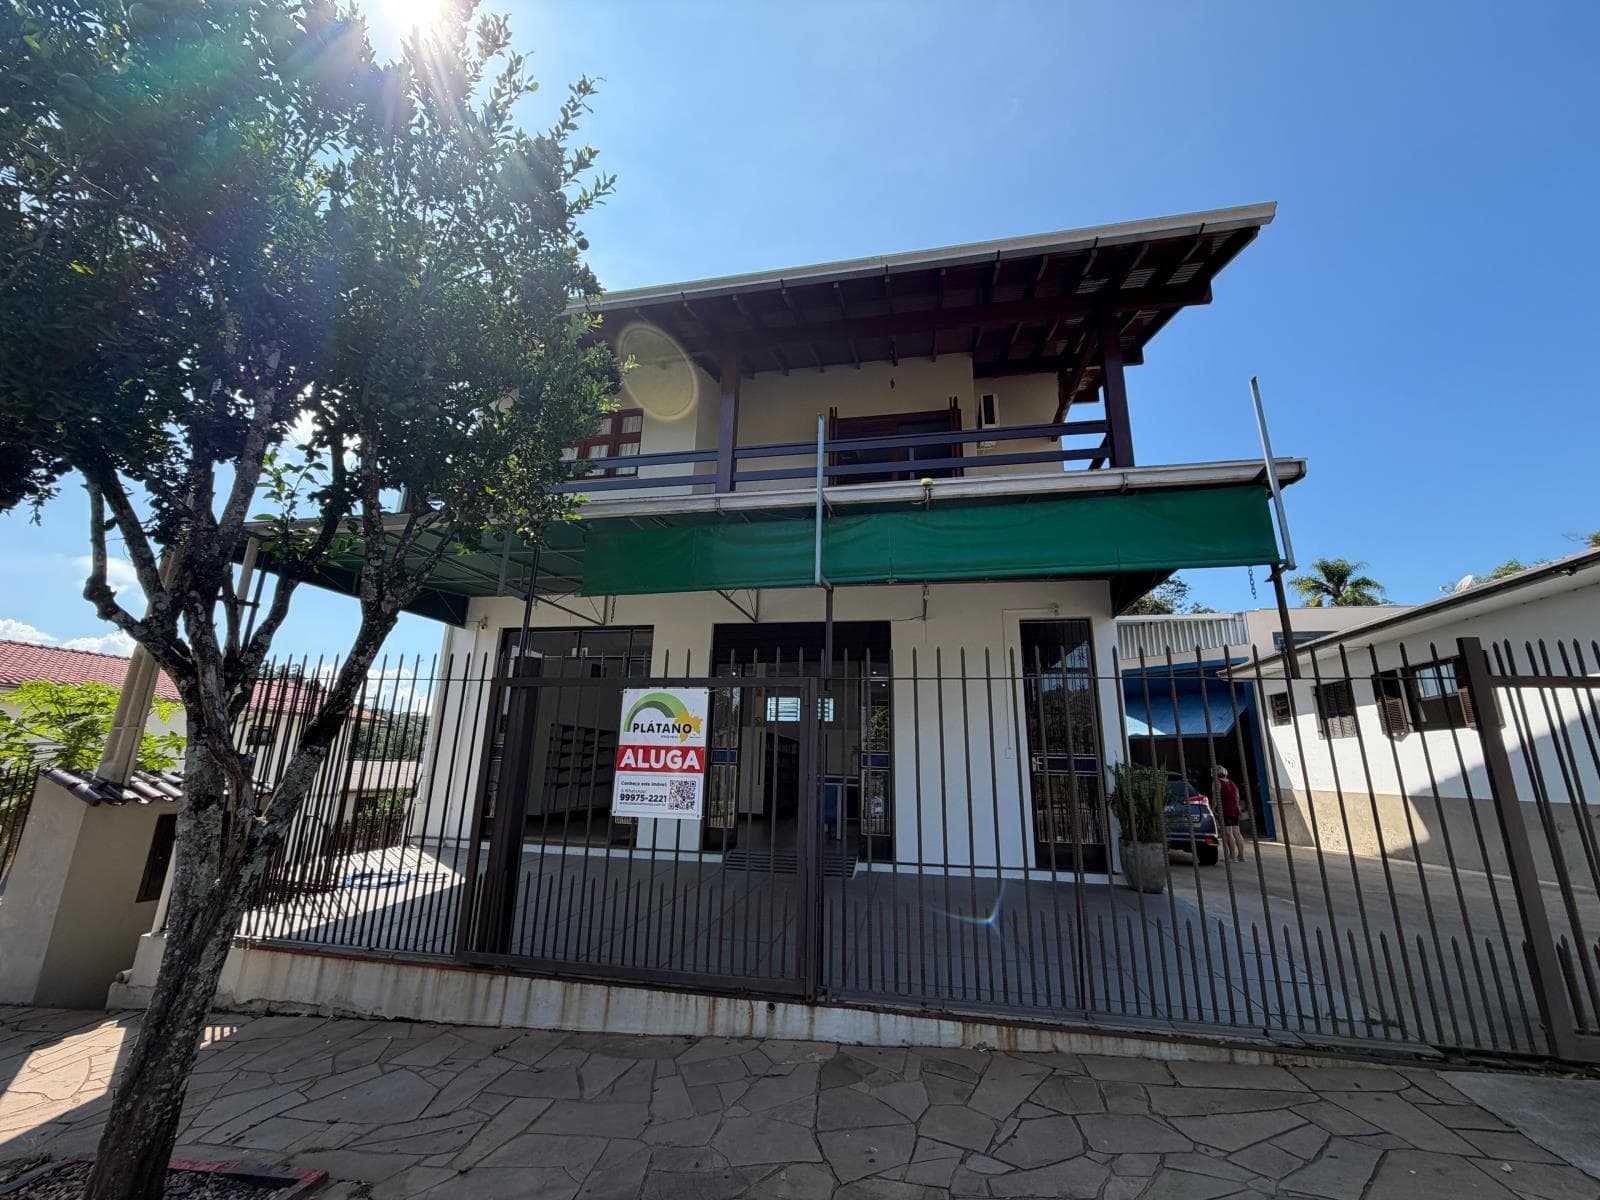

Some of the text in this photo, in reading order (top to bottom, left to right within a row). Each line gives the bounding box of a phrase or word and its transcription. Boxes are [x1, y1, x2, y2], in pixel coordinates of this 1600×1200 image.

[632, 720, 692, 734] PLÁTANO
[620, 748, 700, 770] ALUGA
[619, 793, 667, 803] 99975-2221
